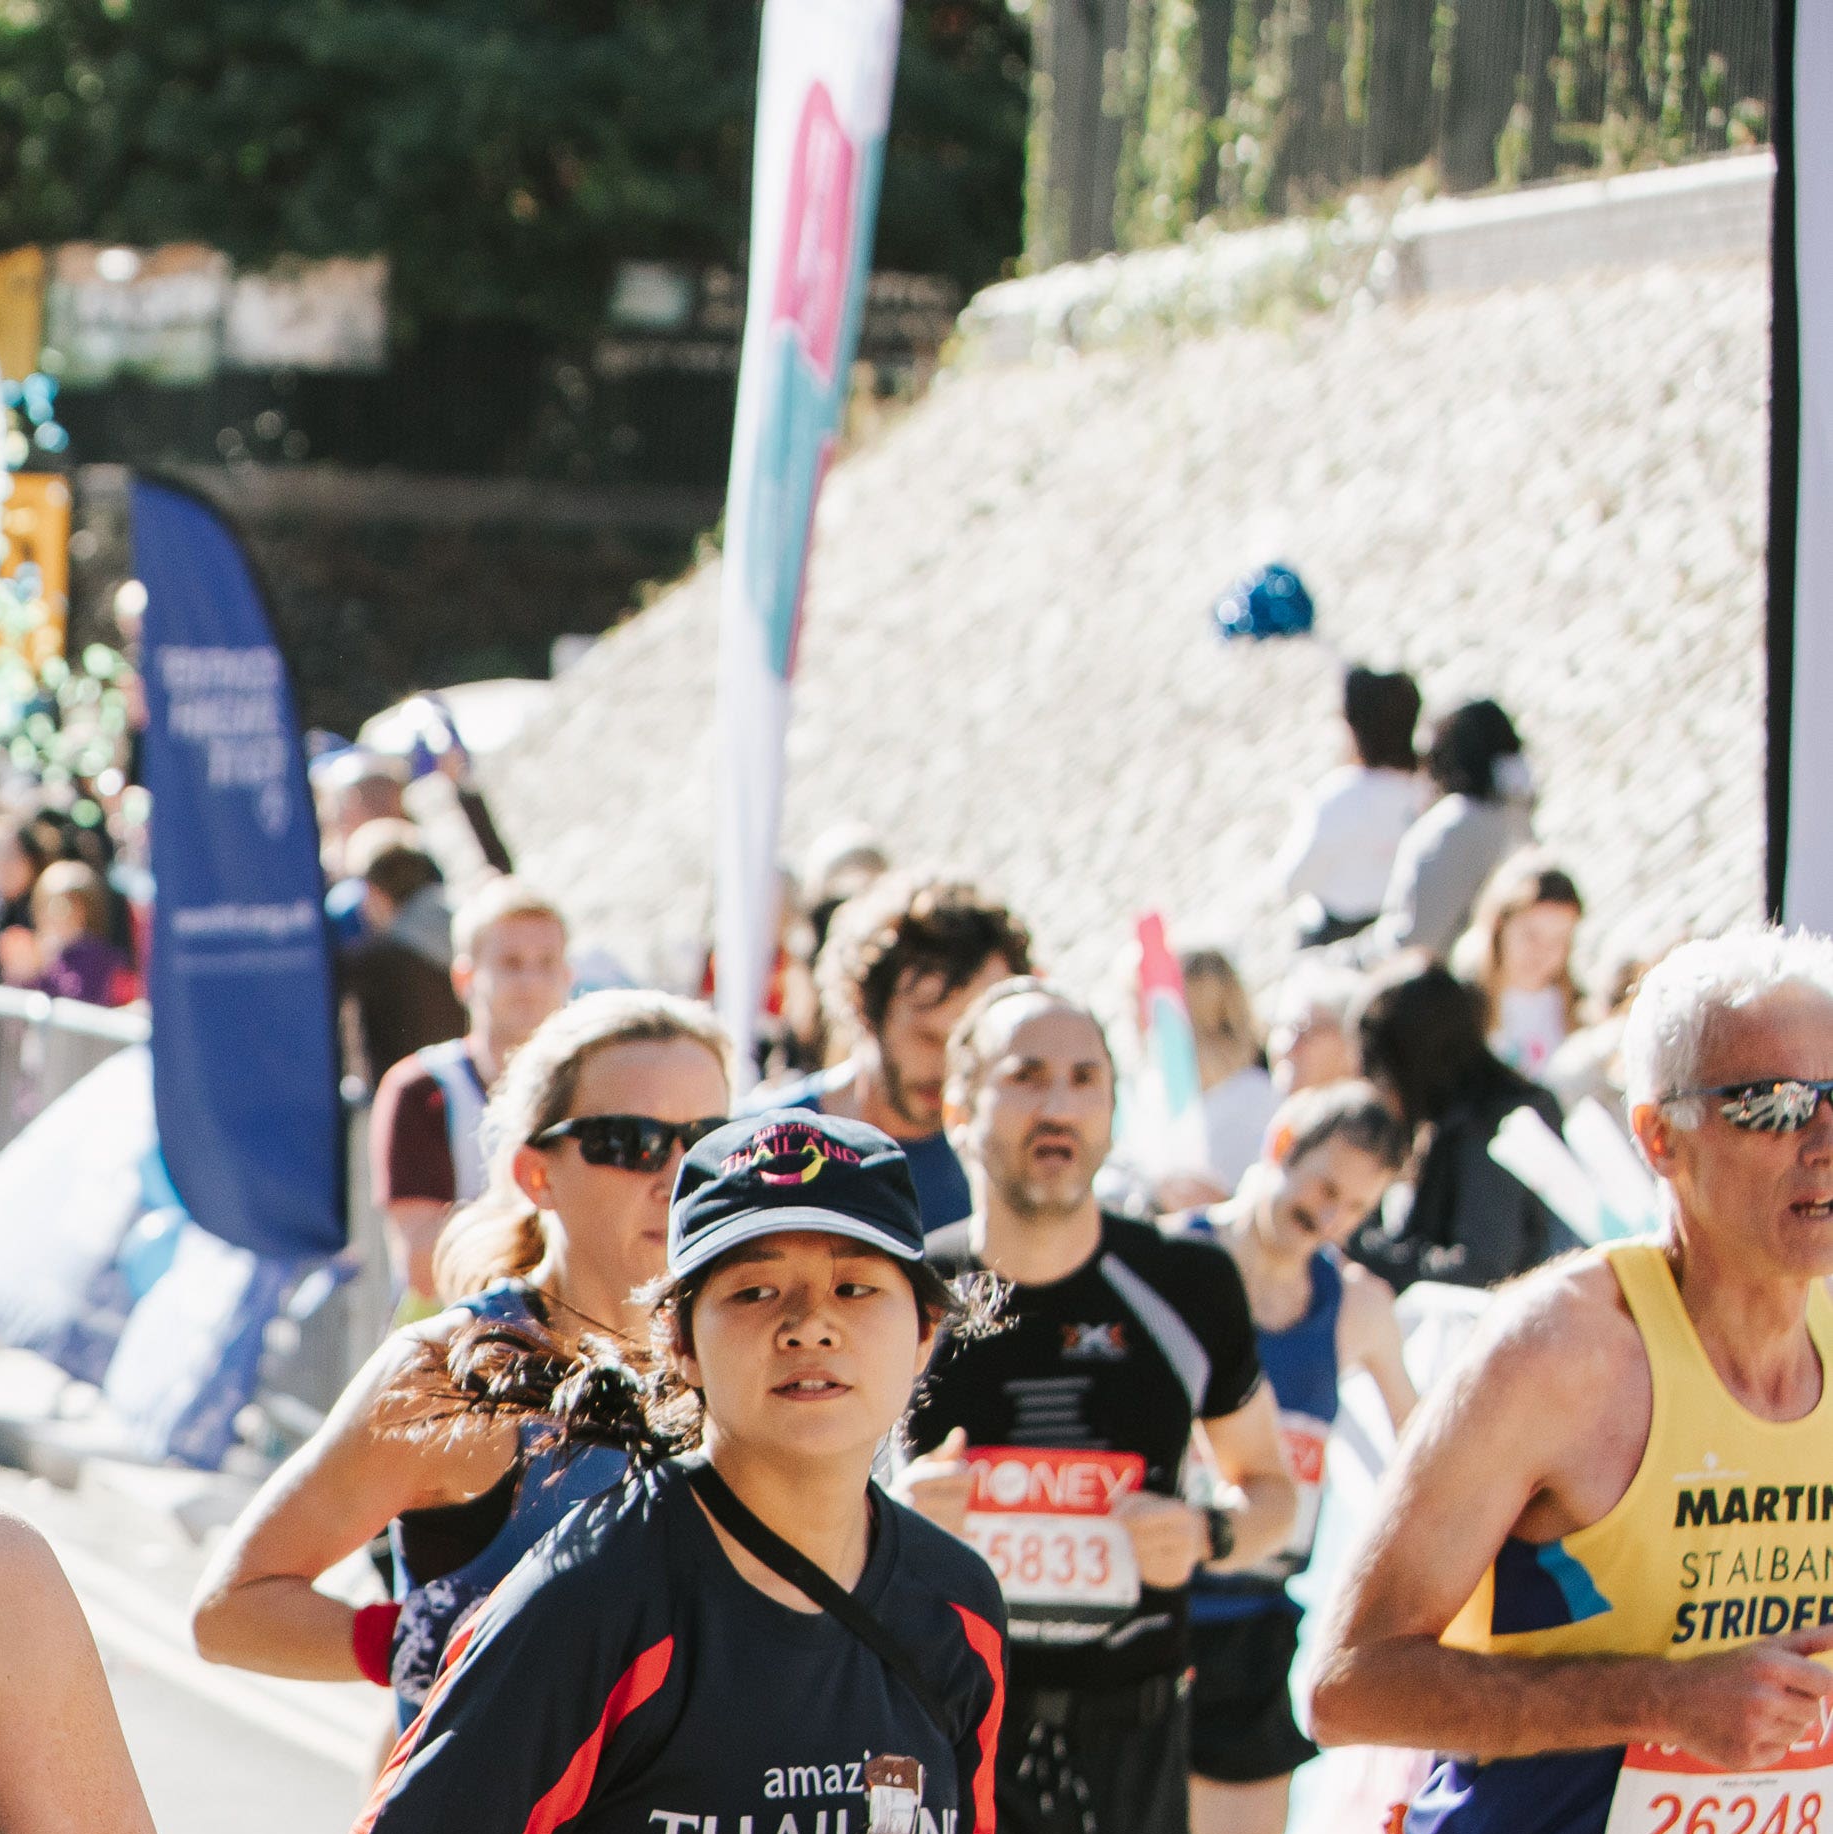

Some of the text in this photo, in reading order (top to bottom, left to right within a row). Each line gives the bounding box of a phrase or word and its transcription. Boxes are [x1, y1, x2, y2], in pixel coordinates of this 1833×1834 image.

[753, 1123, 822, 1142] amazing
[721, 1136, 861, 1175] THAILAND
[969, 1533, 1109, 1586] 5833
[764, 1749, 871, 1799] amaz
